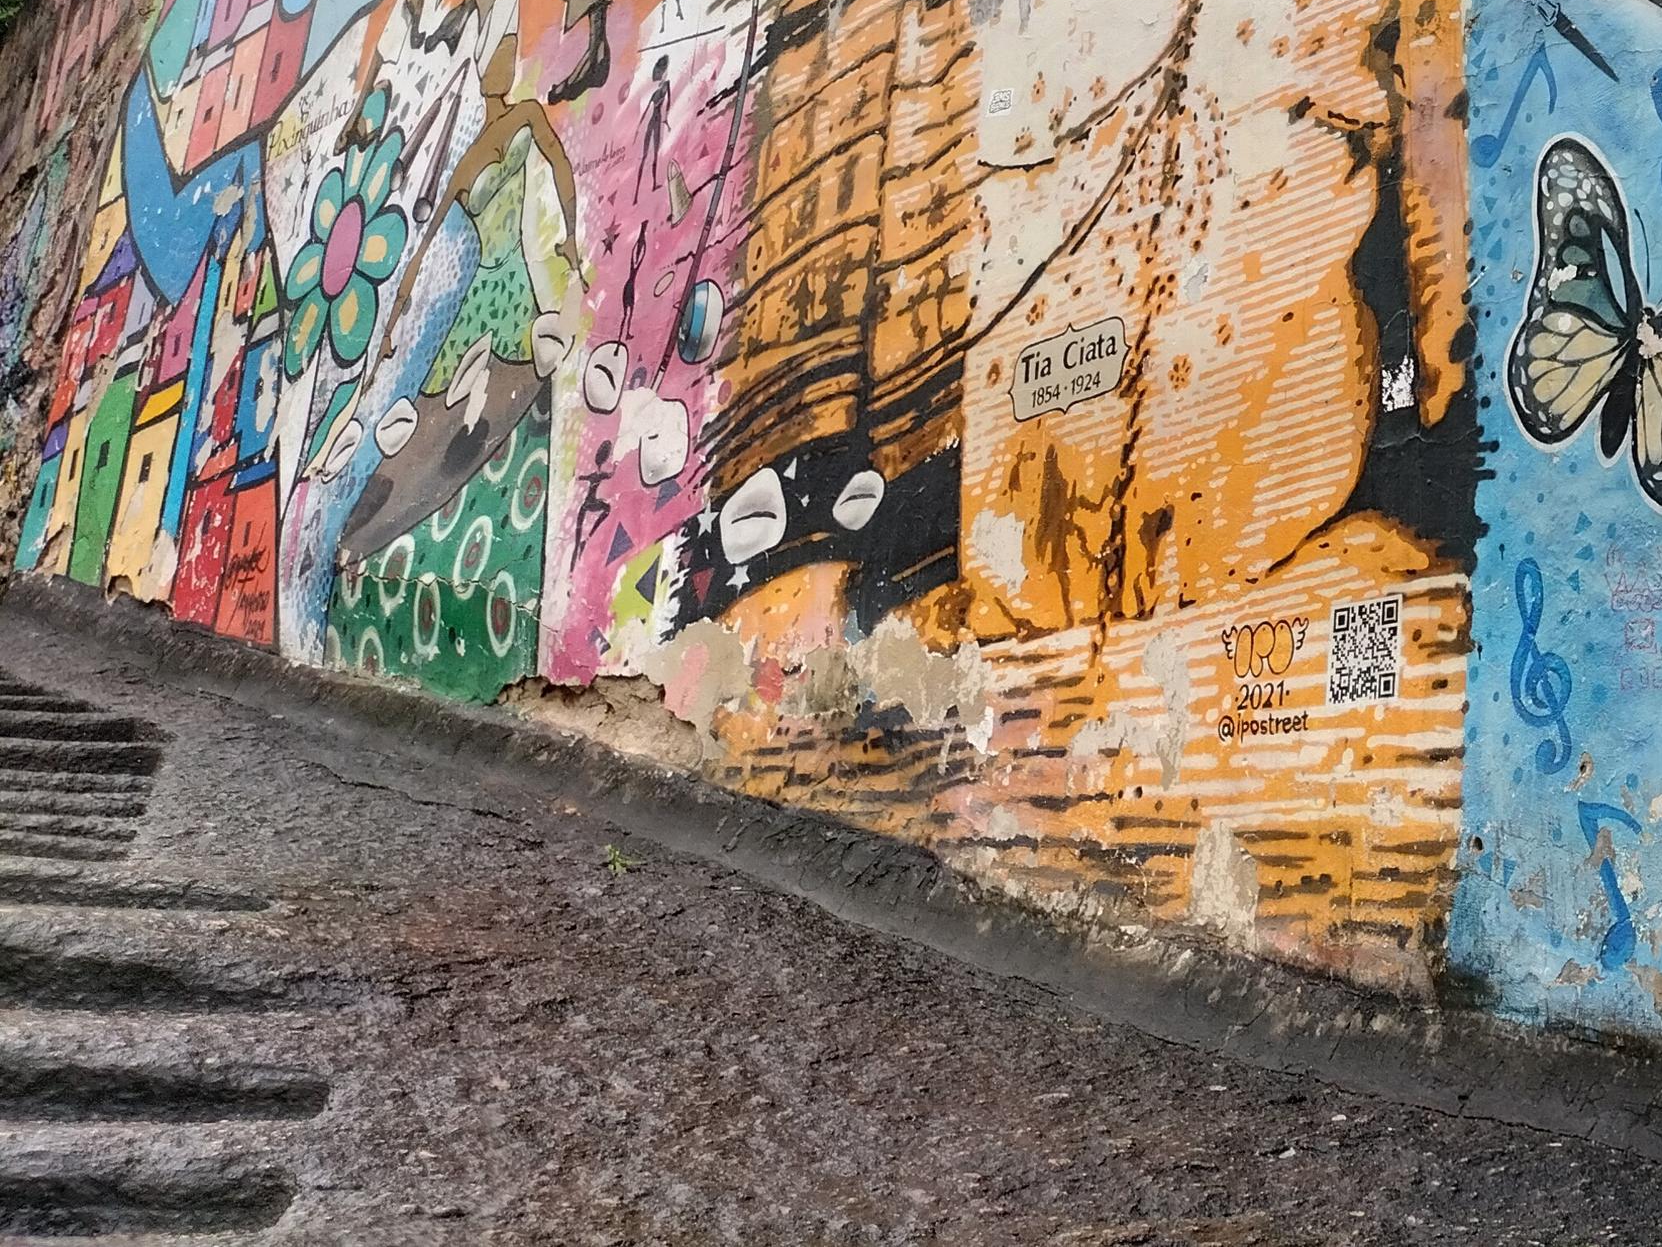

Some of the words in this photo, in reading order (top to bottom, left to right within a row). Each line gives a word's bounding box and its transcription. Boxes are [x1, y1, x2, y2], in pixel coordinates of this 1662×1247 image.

[1021, 351, 1052, 384] Tia
[1063, 333, 1118, 370] Ciata
[1217, 710, 1310, 743] @ipostreet
